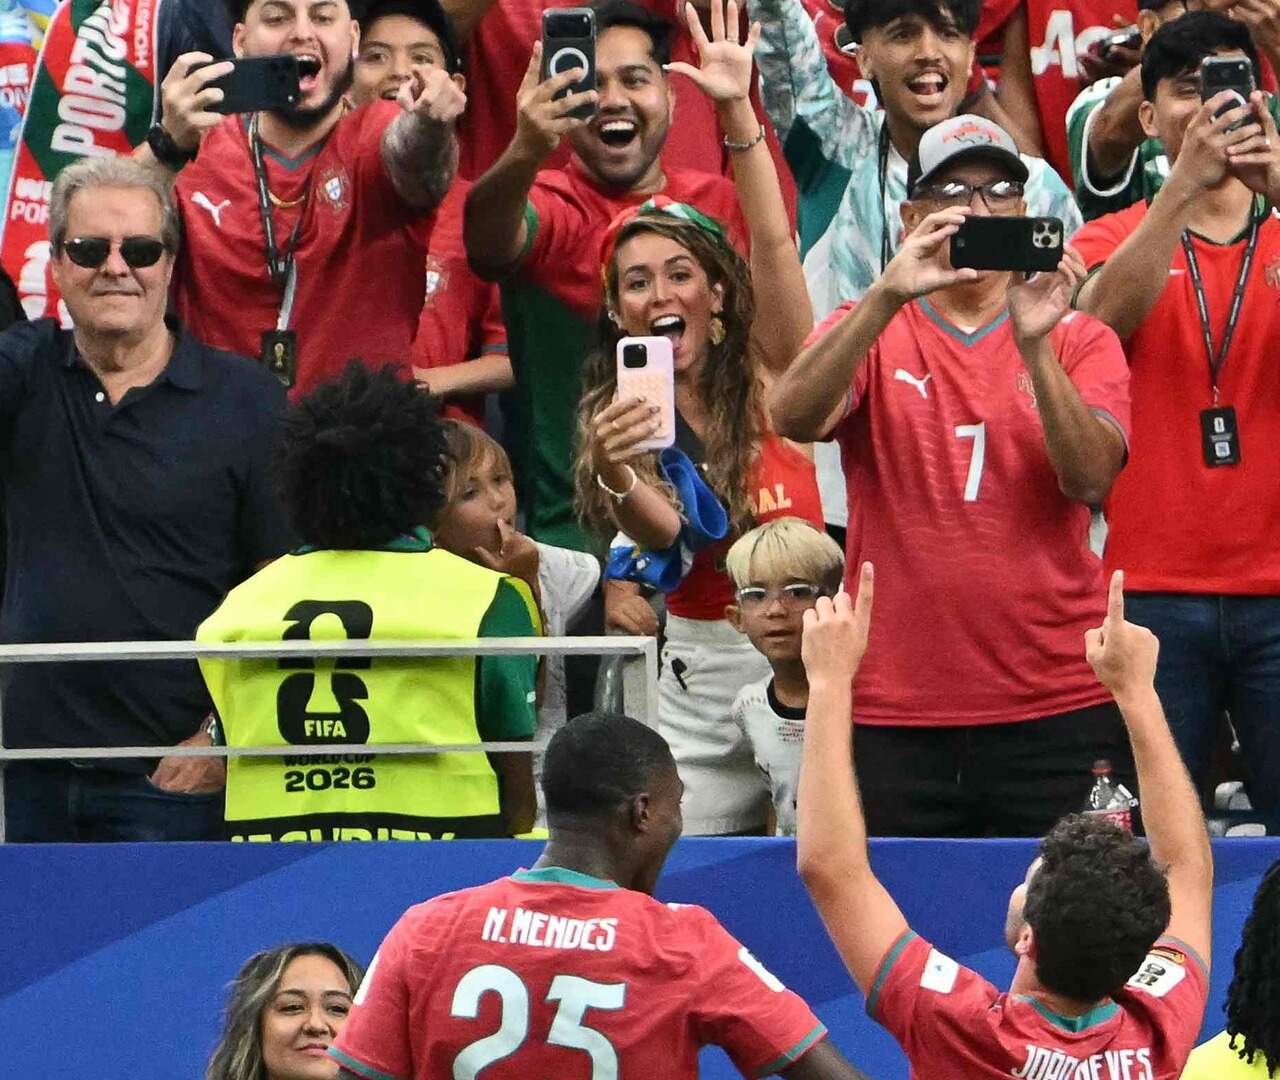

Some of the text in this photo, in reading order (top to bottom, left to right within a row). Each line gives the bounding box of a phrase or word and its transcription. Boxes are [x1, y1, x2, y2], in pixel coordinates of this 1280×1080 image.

[954, 421, 987, 502] 7
[304, 719, 347, 738] FIFA
[284, 767, 376, 793] 2026
